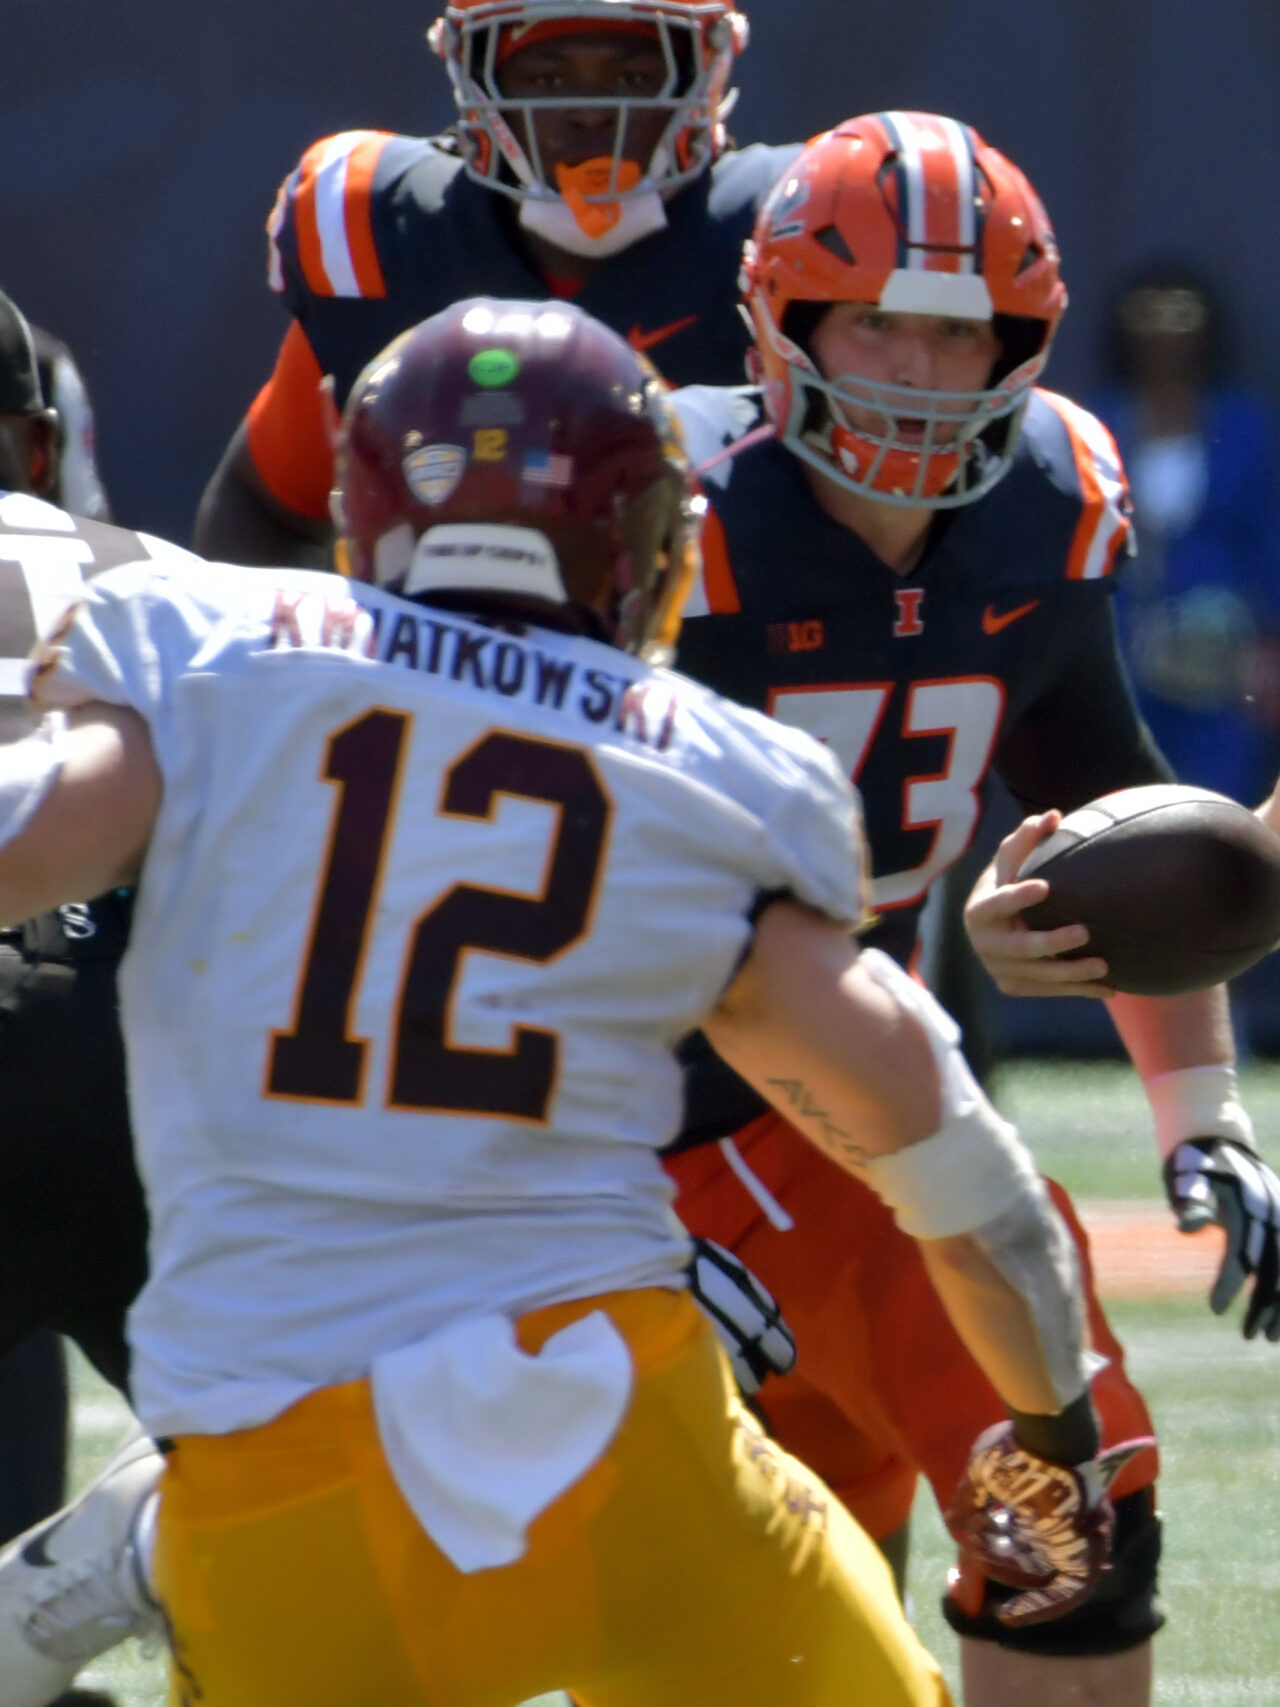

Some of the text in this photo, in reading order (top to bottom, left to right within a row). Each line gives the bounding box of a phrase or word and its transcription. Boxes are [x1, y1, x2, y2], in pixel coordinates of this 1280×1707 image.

[893, 587, 925, 638] I
[766, 674, 1007, 912] 73
[262, 704, 617, 1128] 12
